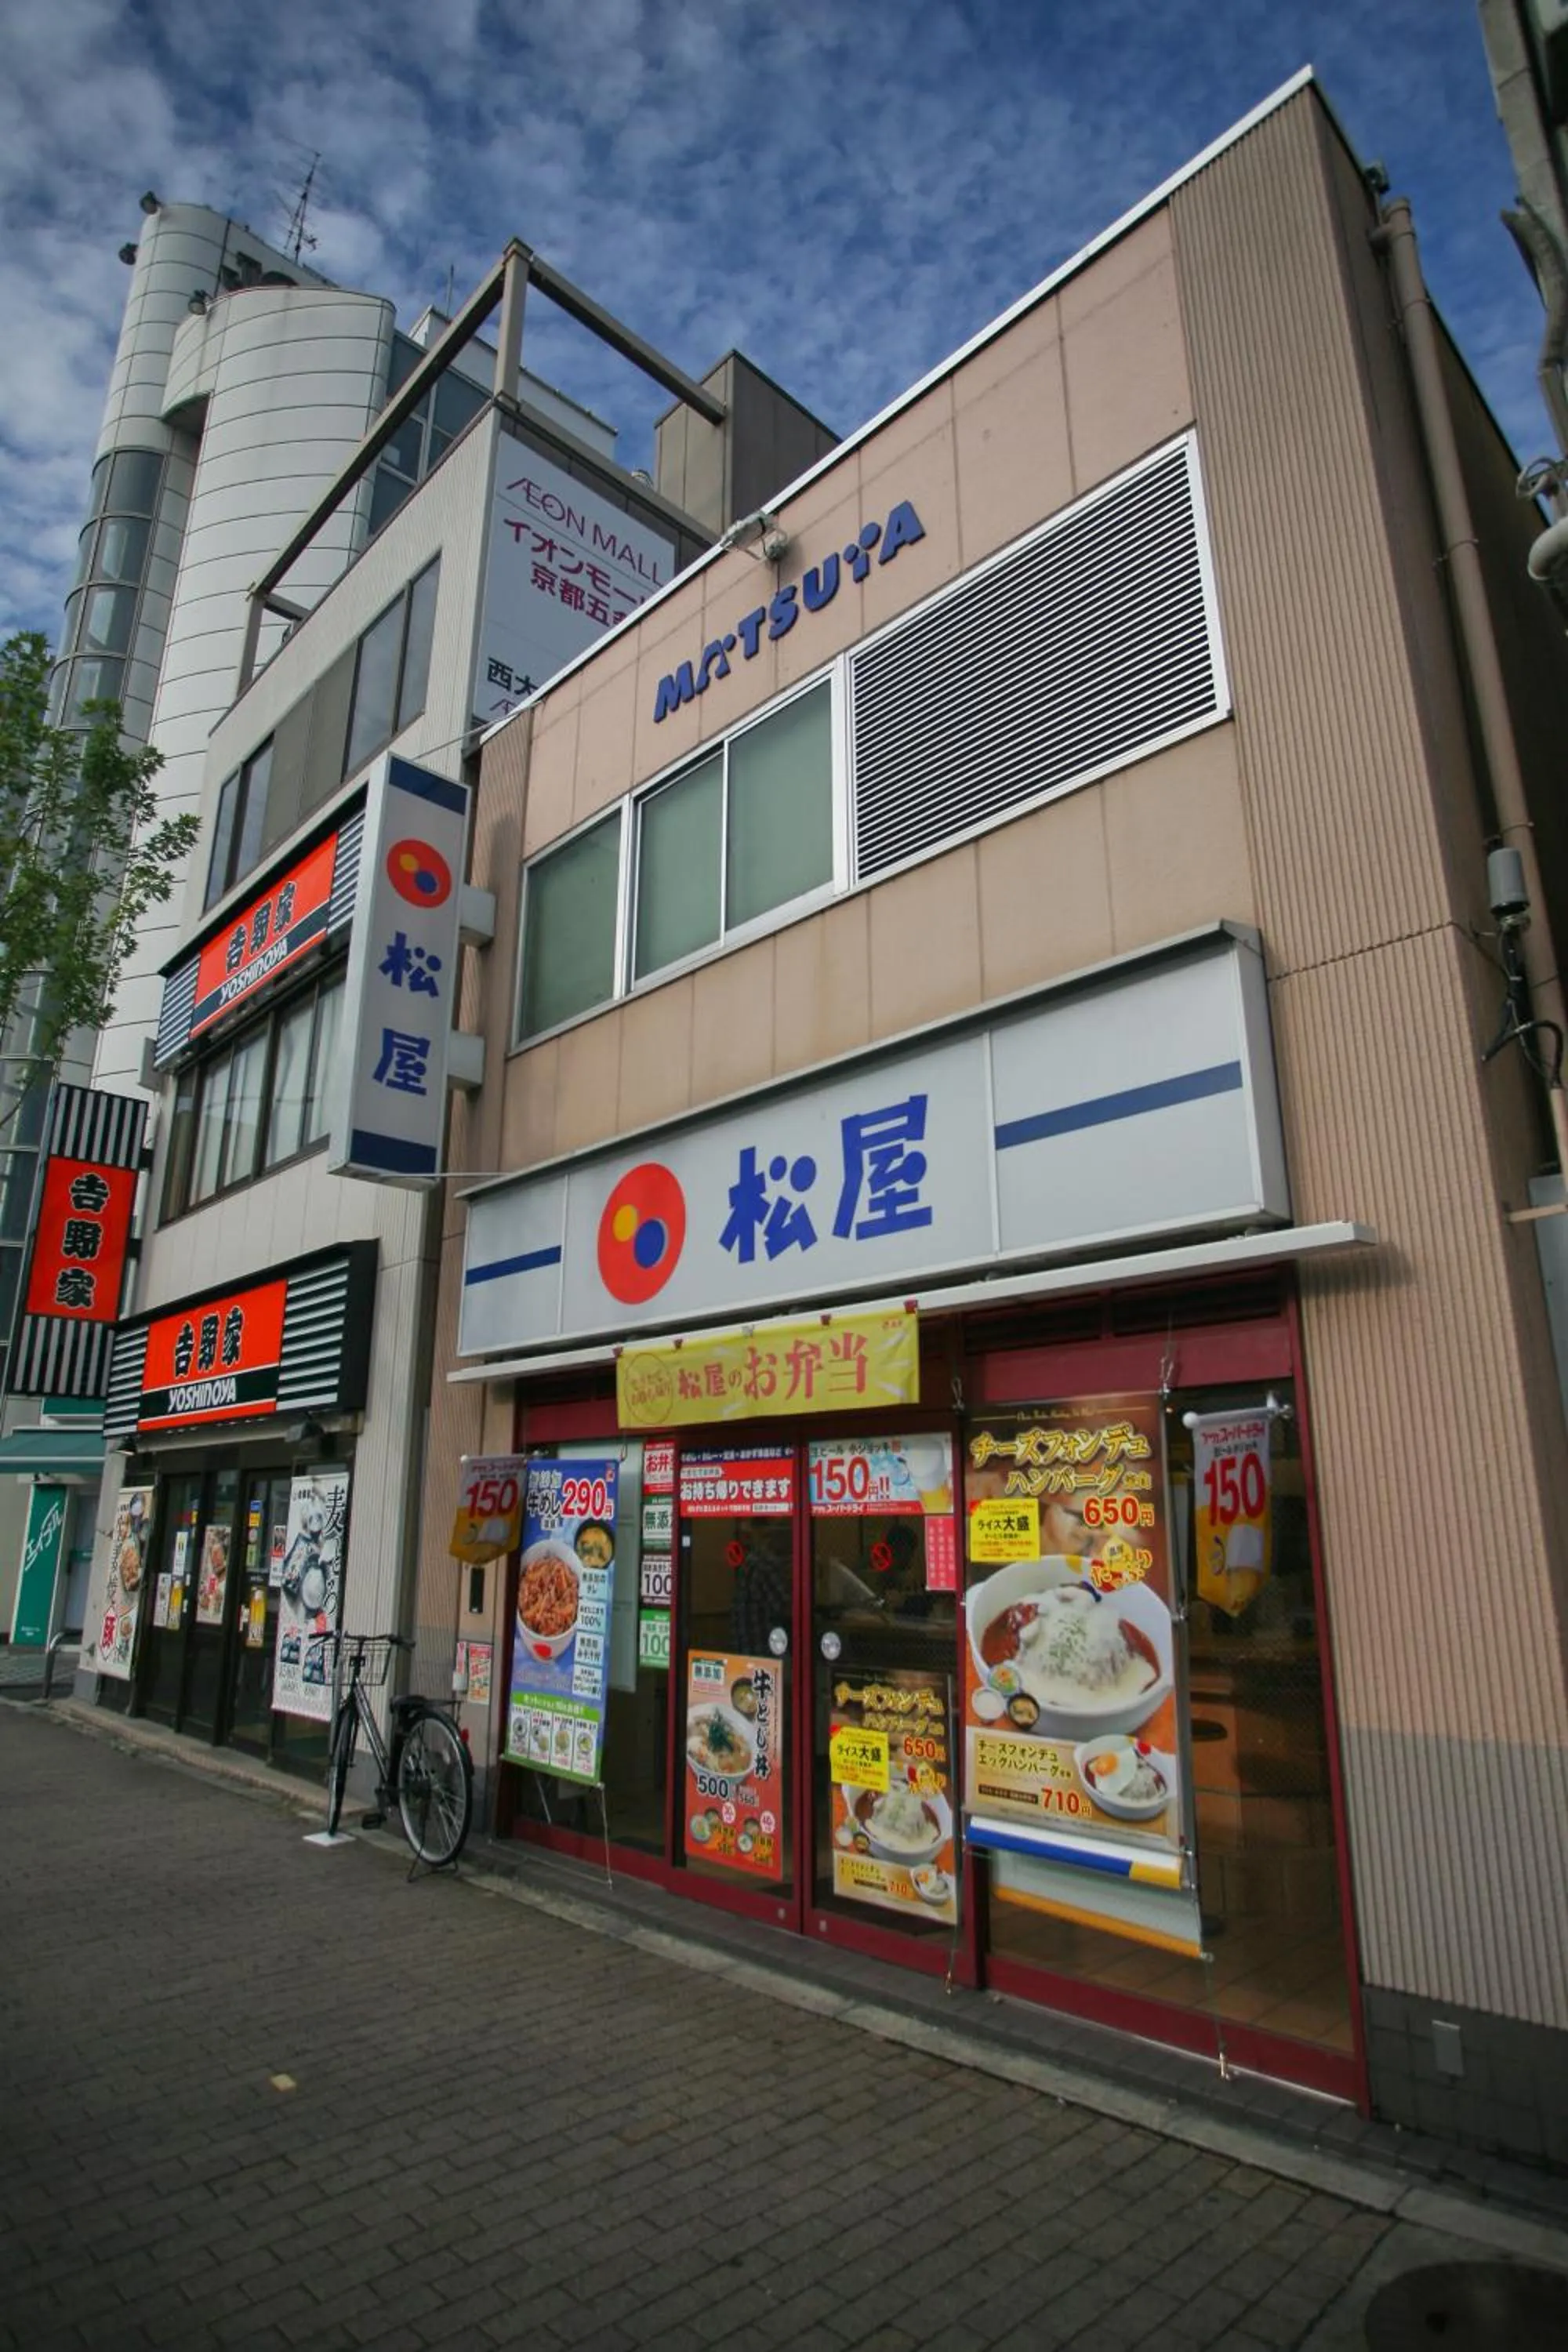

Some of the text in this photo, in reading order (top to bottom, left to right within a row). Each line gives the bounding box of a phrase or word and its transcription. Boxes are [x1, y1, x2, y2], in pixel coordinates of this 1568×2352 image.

[503, 518, 649, 605] イオンモー
[592, 523, 665, 589] MALL
[653, 499, 927, 723] MATSUYA
[219, 938, 289, 1006] YOSHINOYA
[372, 931, 442, 1096] 松屋
[718, 1094, 933, 1264] 松屋
[54, 1172, 111, 1309] 吉野家
[168, 1377, 236, 1414] YOSHINOYA
[677, 1330, 869, 1401] 松屋のお弁当
[970, 1421, 1153, 1468] チーズフォンデュ
[466, 1479, 519, 1519] 150
[680, 1477, 791, 1501] お持ち帰りできます
[1204, 1452, 1265, 1526] 150
